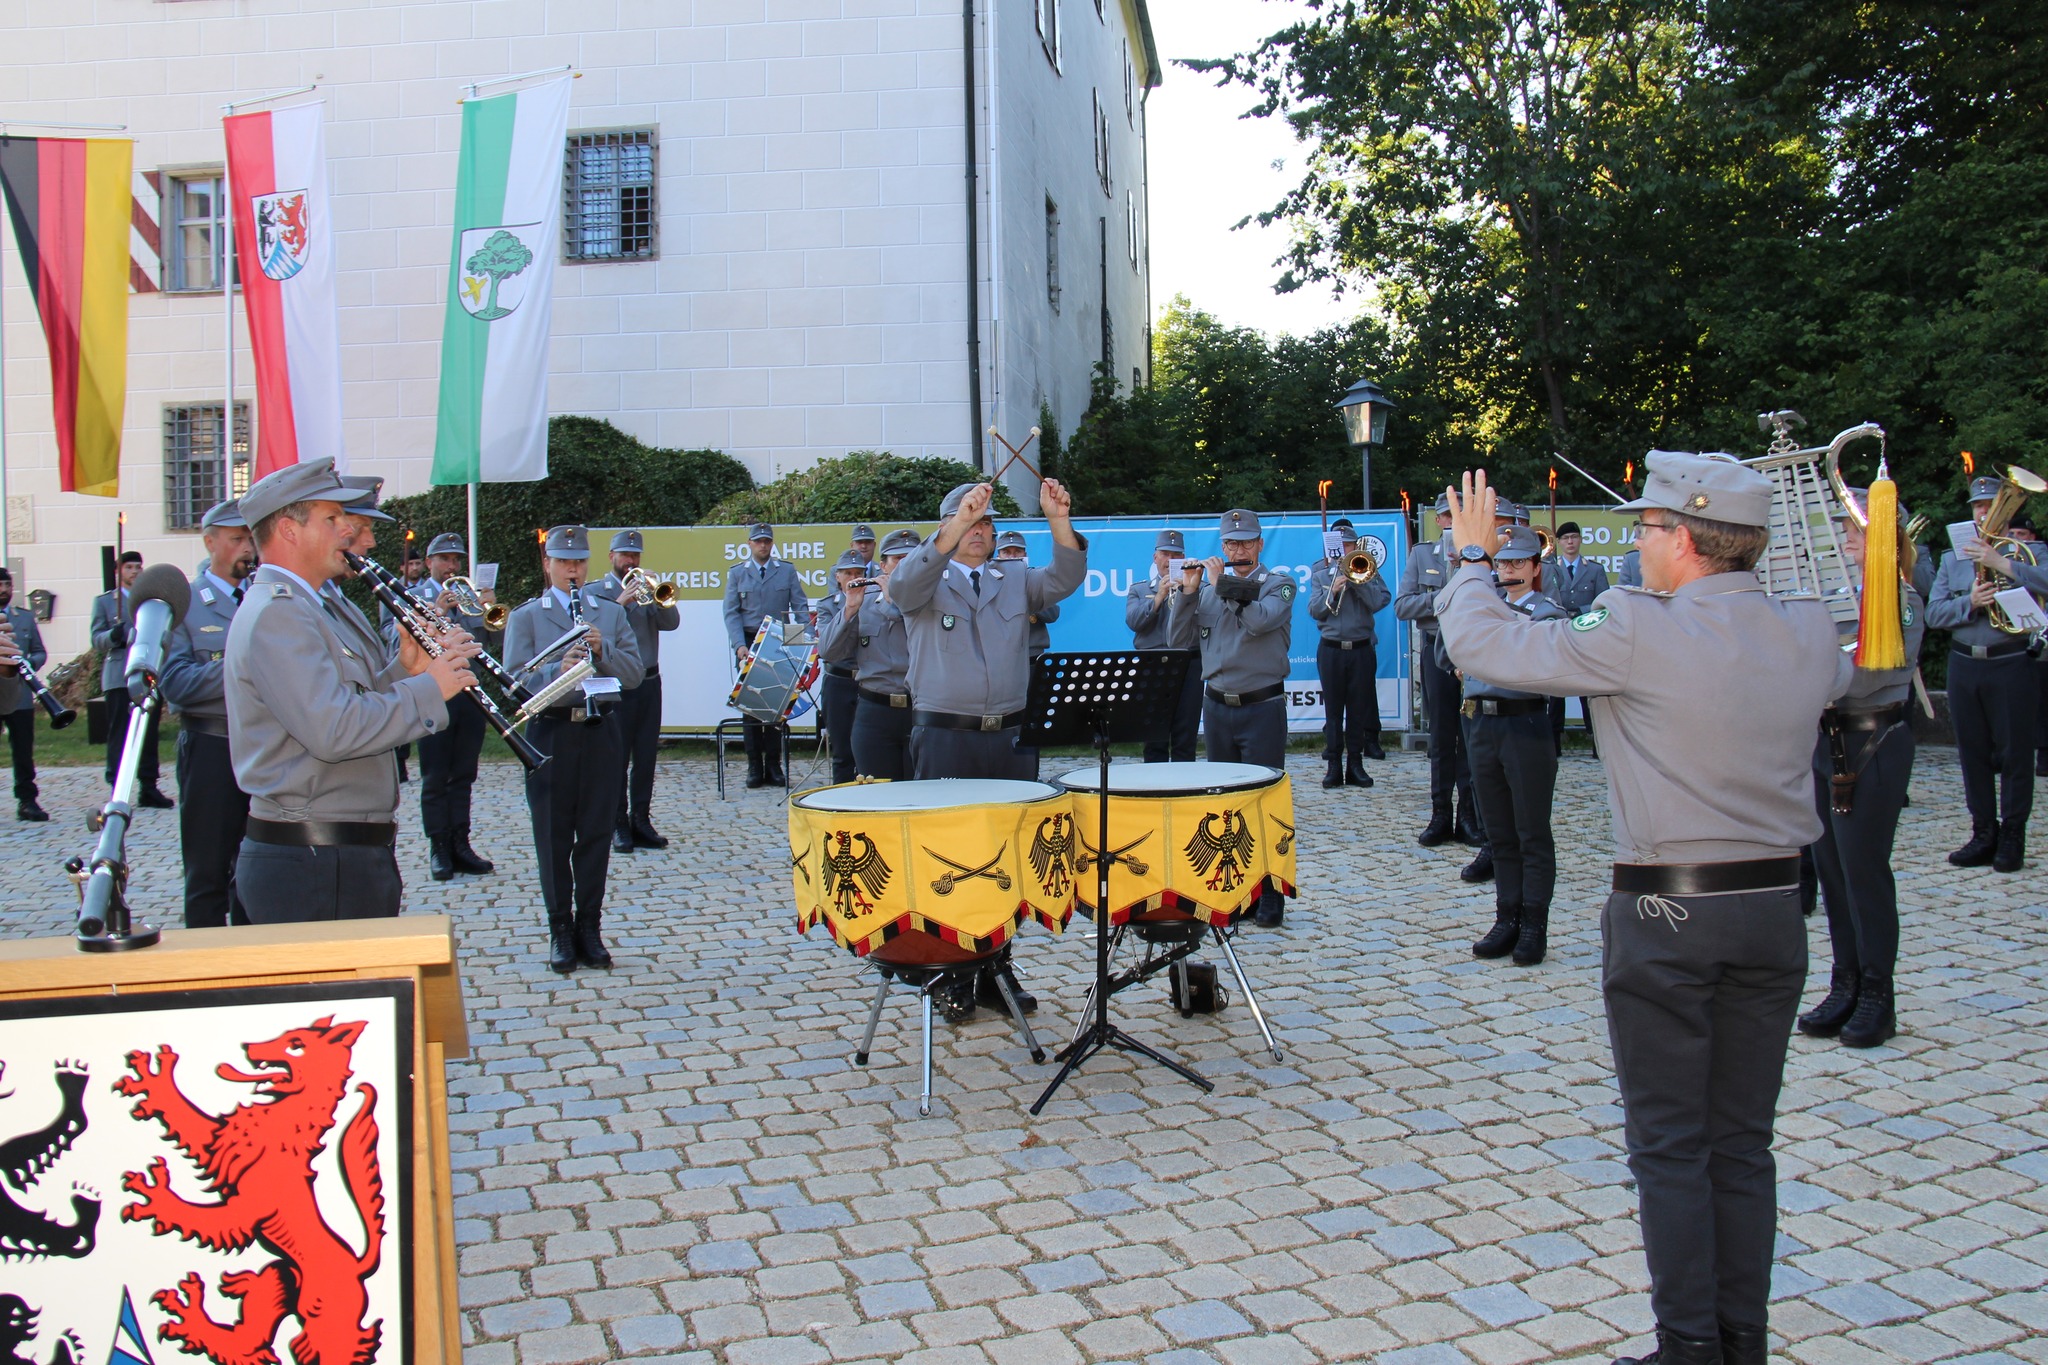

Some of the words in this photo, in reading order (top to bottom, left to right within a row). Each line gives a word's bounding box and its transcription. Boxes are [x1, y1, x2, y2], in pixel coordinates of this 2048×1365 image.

[1581, 526, 1612, 545] 50
[724, 543, 752, 560] 50
[770, 541, 826, 559] AHRE
[1084, 568, 1133, 597] DU
